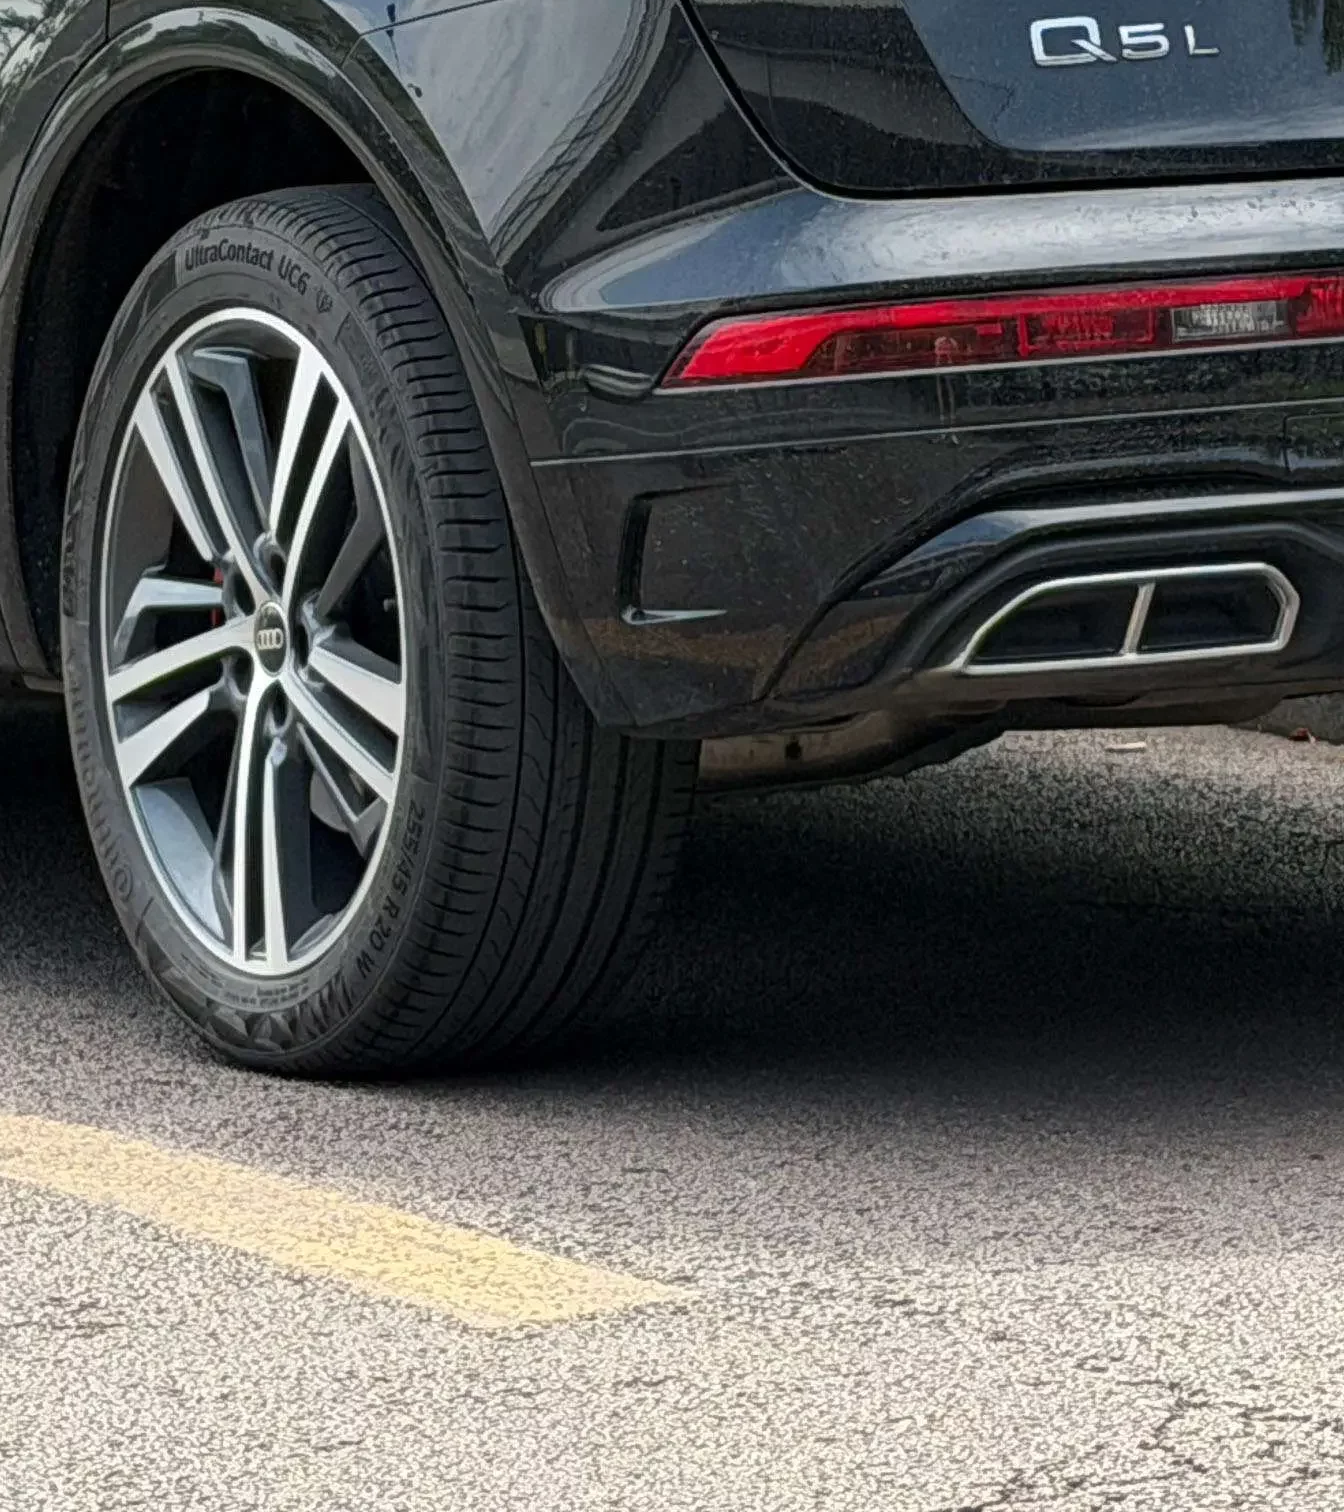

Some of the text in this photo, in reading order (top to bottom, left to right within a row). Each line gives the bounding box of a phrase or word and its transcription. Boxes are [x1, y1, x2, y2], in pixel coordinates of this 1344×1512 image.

[184, 238, 311, 296] UltraContact UC6
[369, 913, 392, 953] 20
